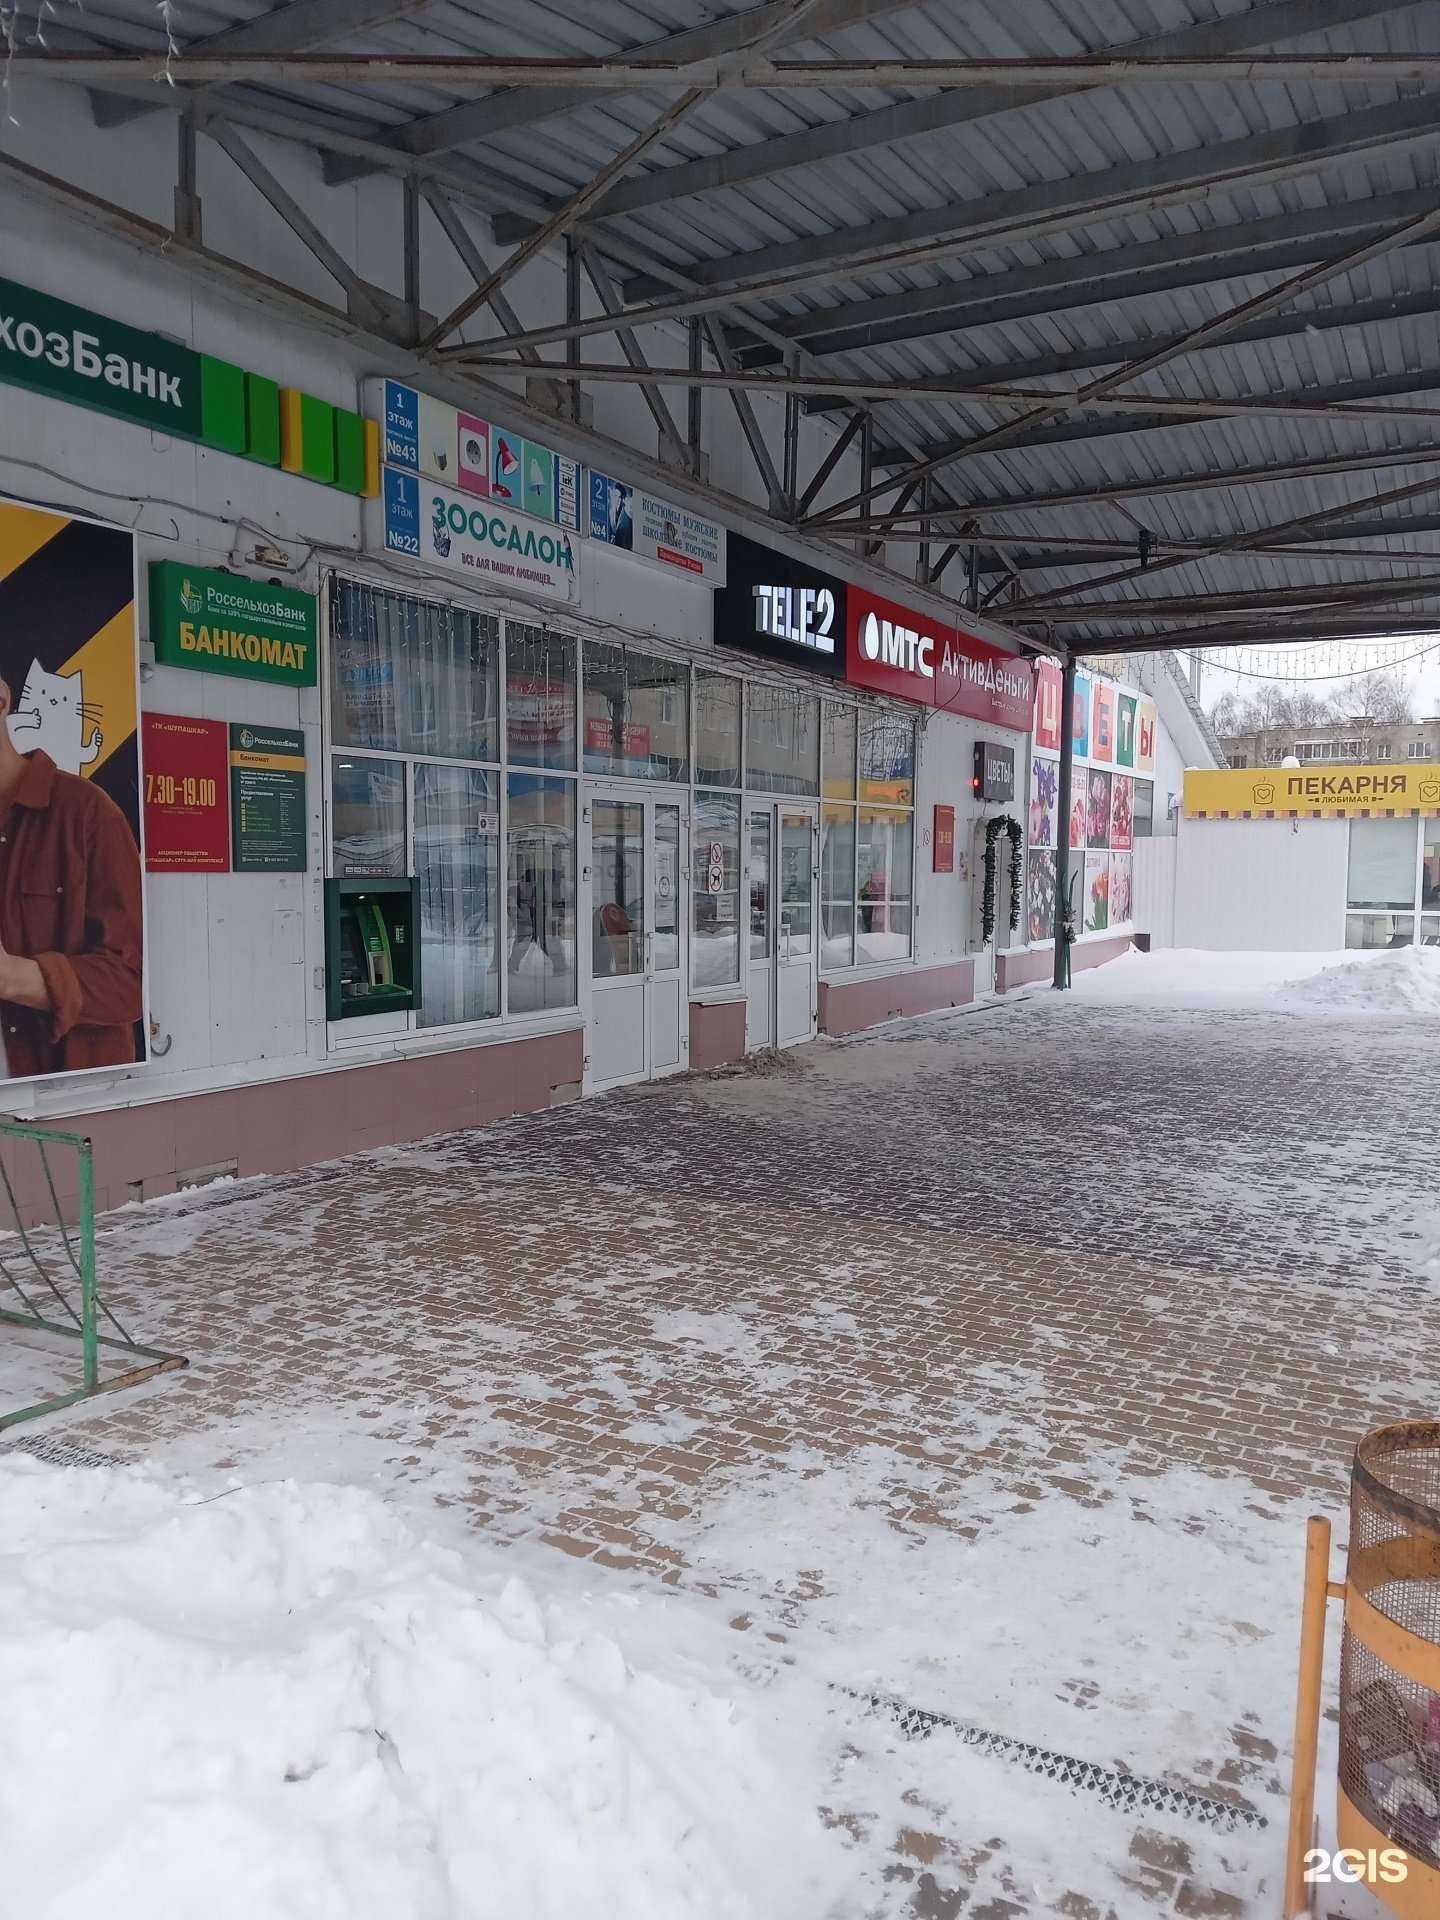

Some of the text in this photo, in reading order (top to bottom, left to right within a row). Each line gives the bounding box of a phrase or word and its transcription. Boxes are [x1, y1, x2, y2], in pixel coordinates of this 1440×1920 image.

[396, 393, 404, 409] 1
[387, 411, 414, 431] этаж
[387, 438, 417, 463] №43
[397, 477, 407, 503] 1
[595, 479, 603, 500] 2
[391, 503, 414, 519] этаж
[388, 531, 418, 553] №22
[432, 497, 572, 569] ЗООСАЛОН
[207, 587, 306, 622] РоссельхозБанк
[752, 585, 835, 654] TELE2
[179, 621, 308, 671] БАНКОМАТ
[881, 619, 1030, 702] МТС АктивДеньги
[987, 758, 1010, 785] ЦВЕТЫ
[1287, 774, 1407, 796] ПЕКАРНЯ
[1321, 796, 1370, 804] ЛЮБИМАЯ
